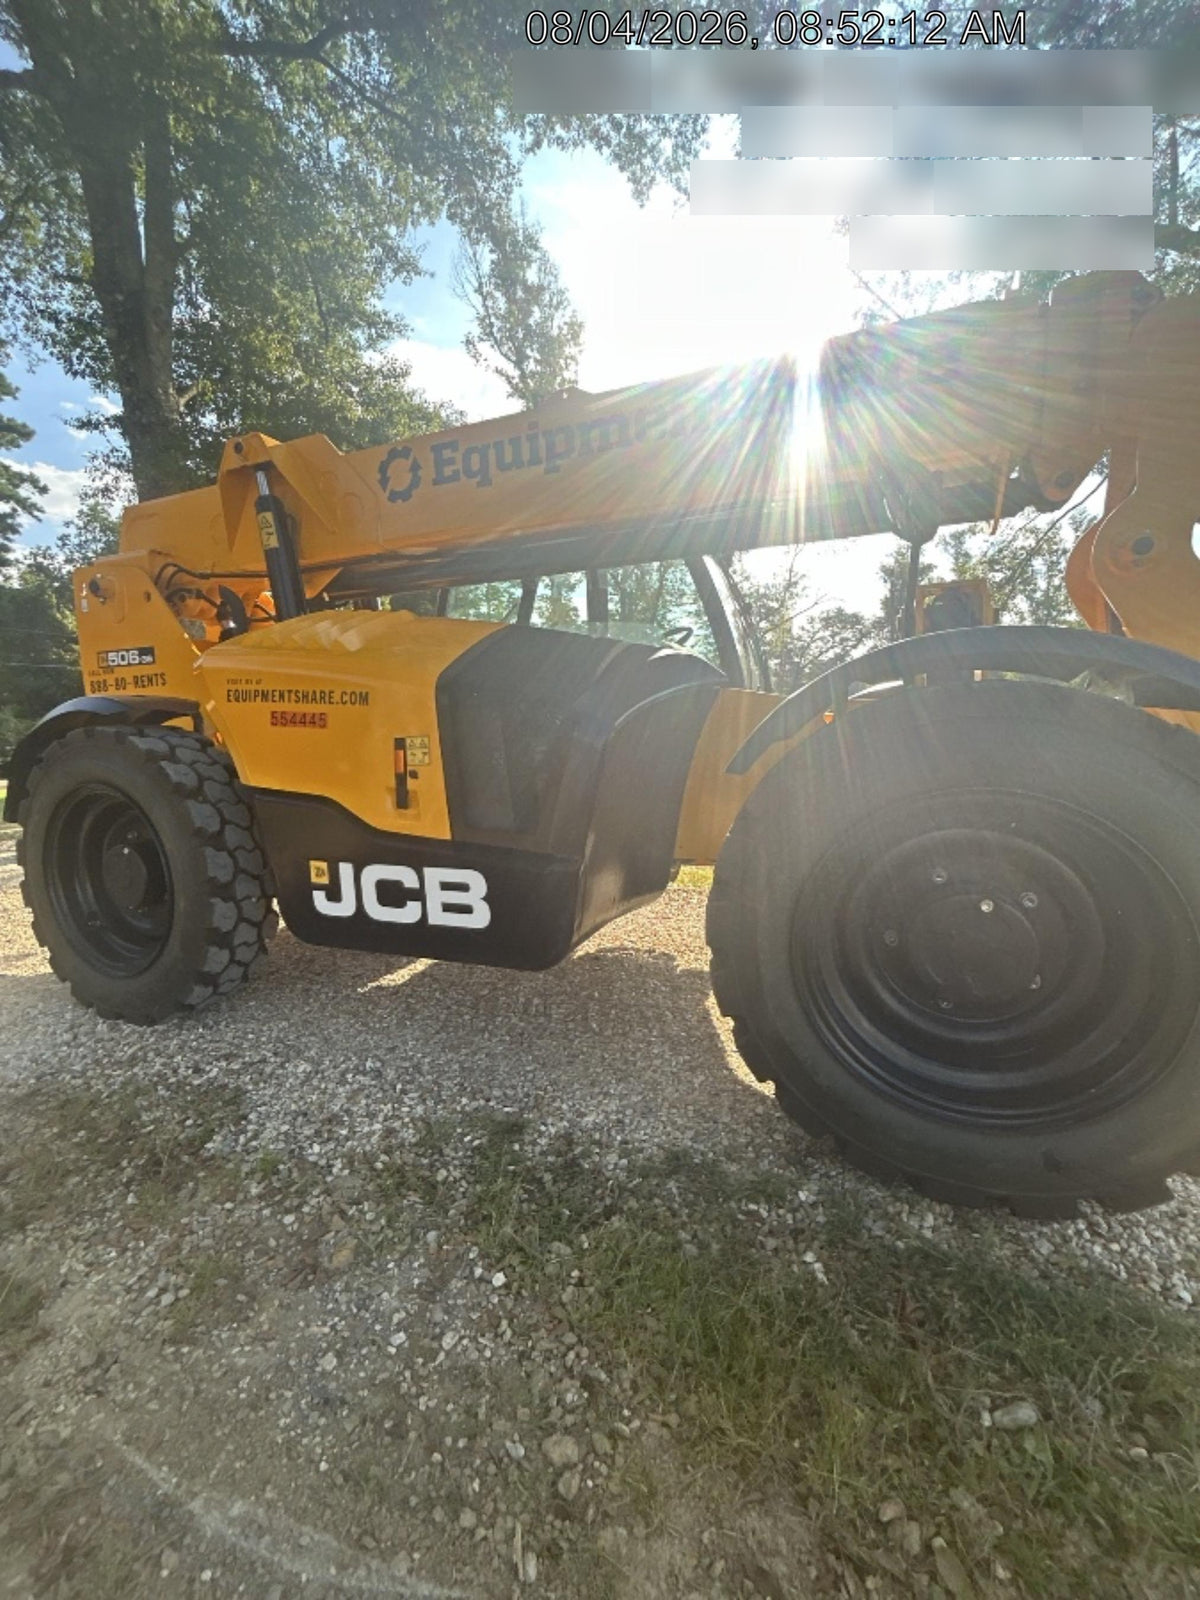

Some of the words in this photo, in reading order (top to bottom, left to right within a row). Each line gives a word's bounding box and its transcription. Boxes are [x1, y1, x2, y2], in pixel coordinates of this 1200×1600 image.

[226, 689, 369, 706] EQUIPMENTSHARE.COM
[270, 711, 328, 728] 554445
[312, 861, 492, 930] JCB
